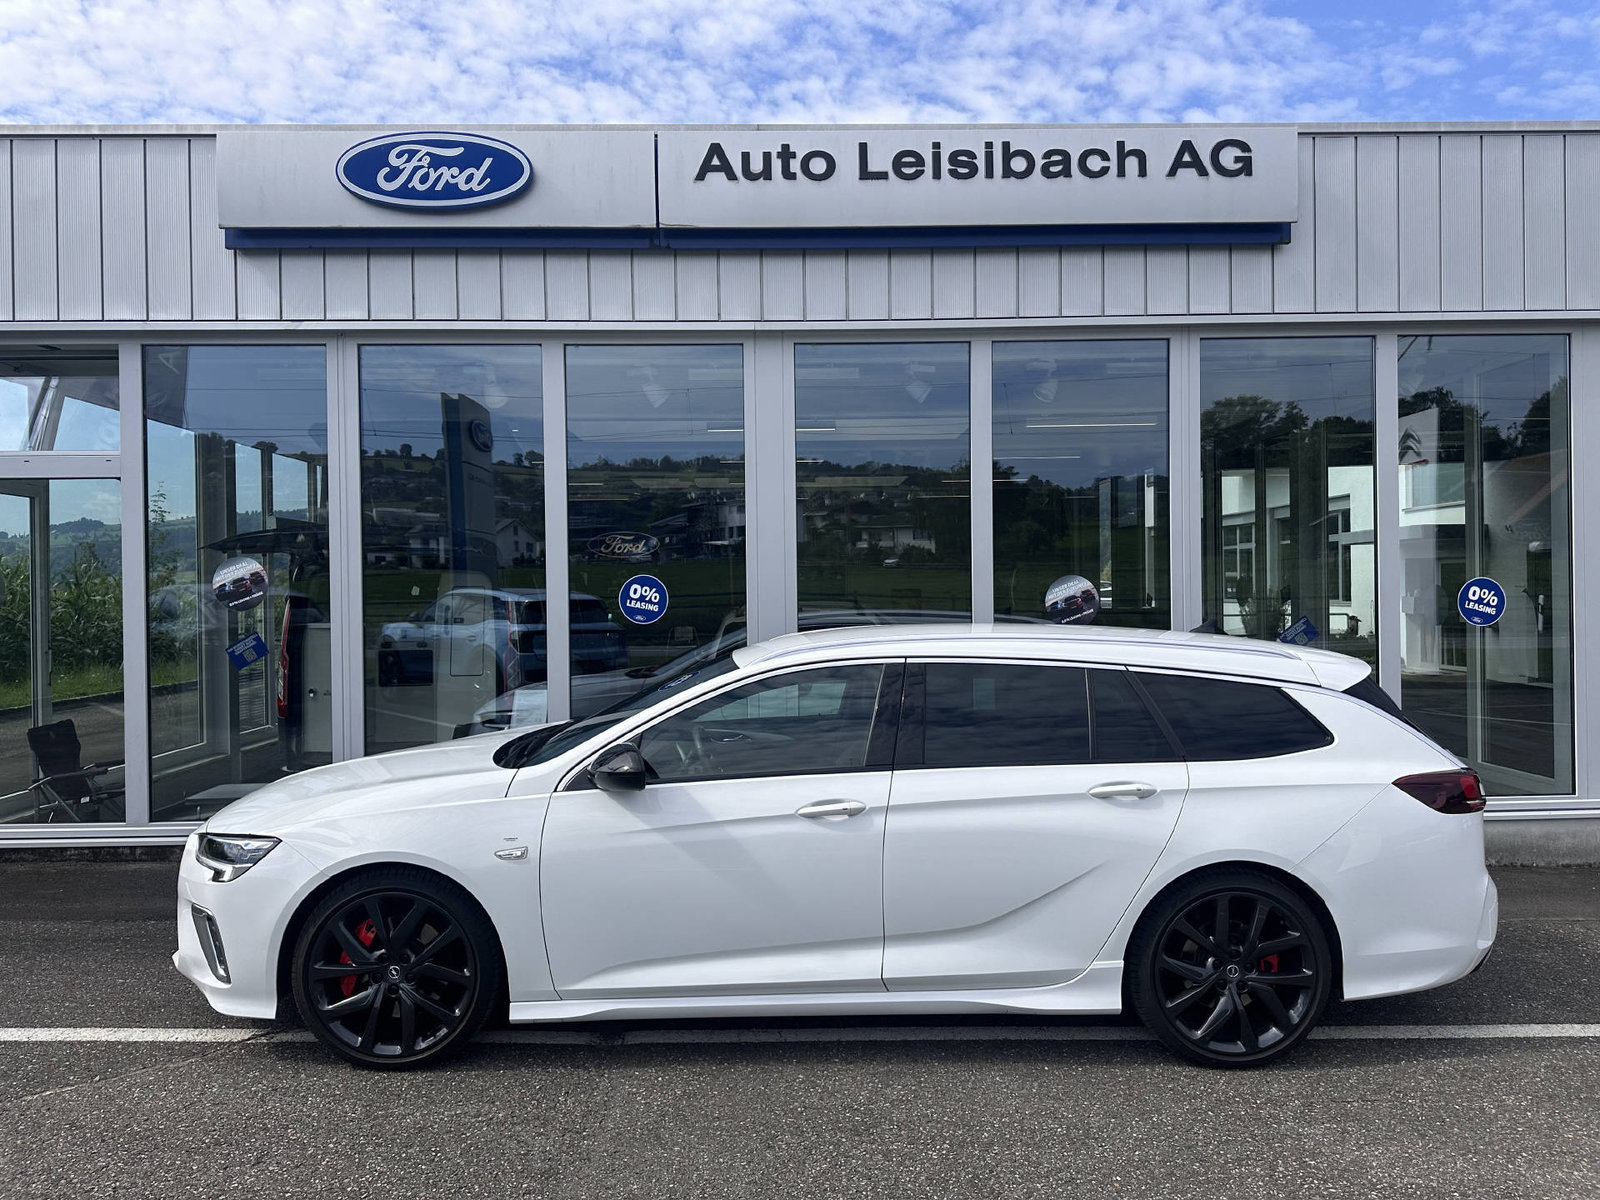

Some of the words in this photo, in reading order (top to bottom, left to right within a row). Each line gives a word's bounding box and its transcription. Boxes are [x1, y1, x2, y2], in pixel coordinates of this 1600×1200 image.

[376, 144, 493, 192] Ford
[695, 143, 836, 181] Auto
[859, 141, 1147, 180] Leisibach
[1166, 139, 1252, 177] AG
[601, 535, 646, 553] Ford
[629, 584, 660, 603] 0%
[1468, 586, 1498, 606] 0%
[626, 600, 659, 612] LEASING
[1465, 601, 1496, 615] LEASING
